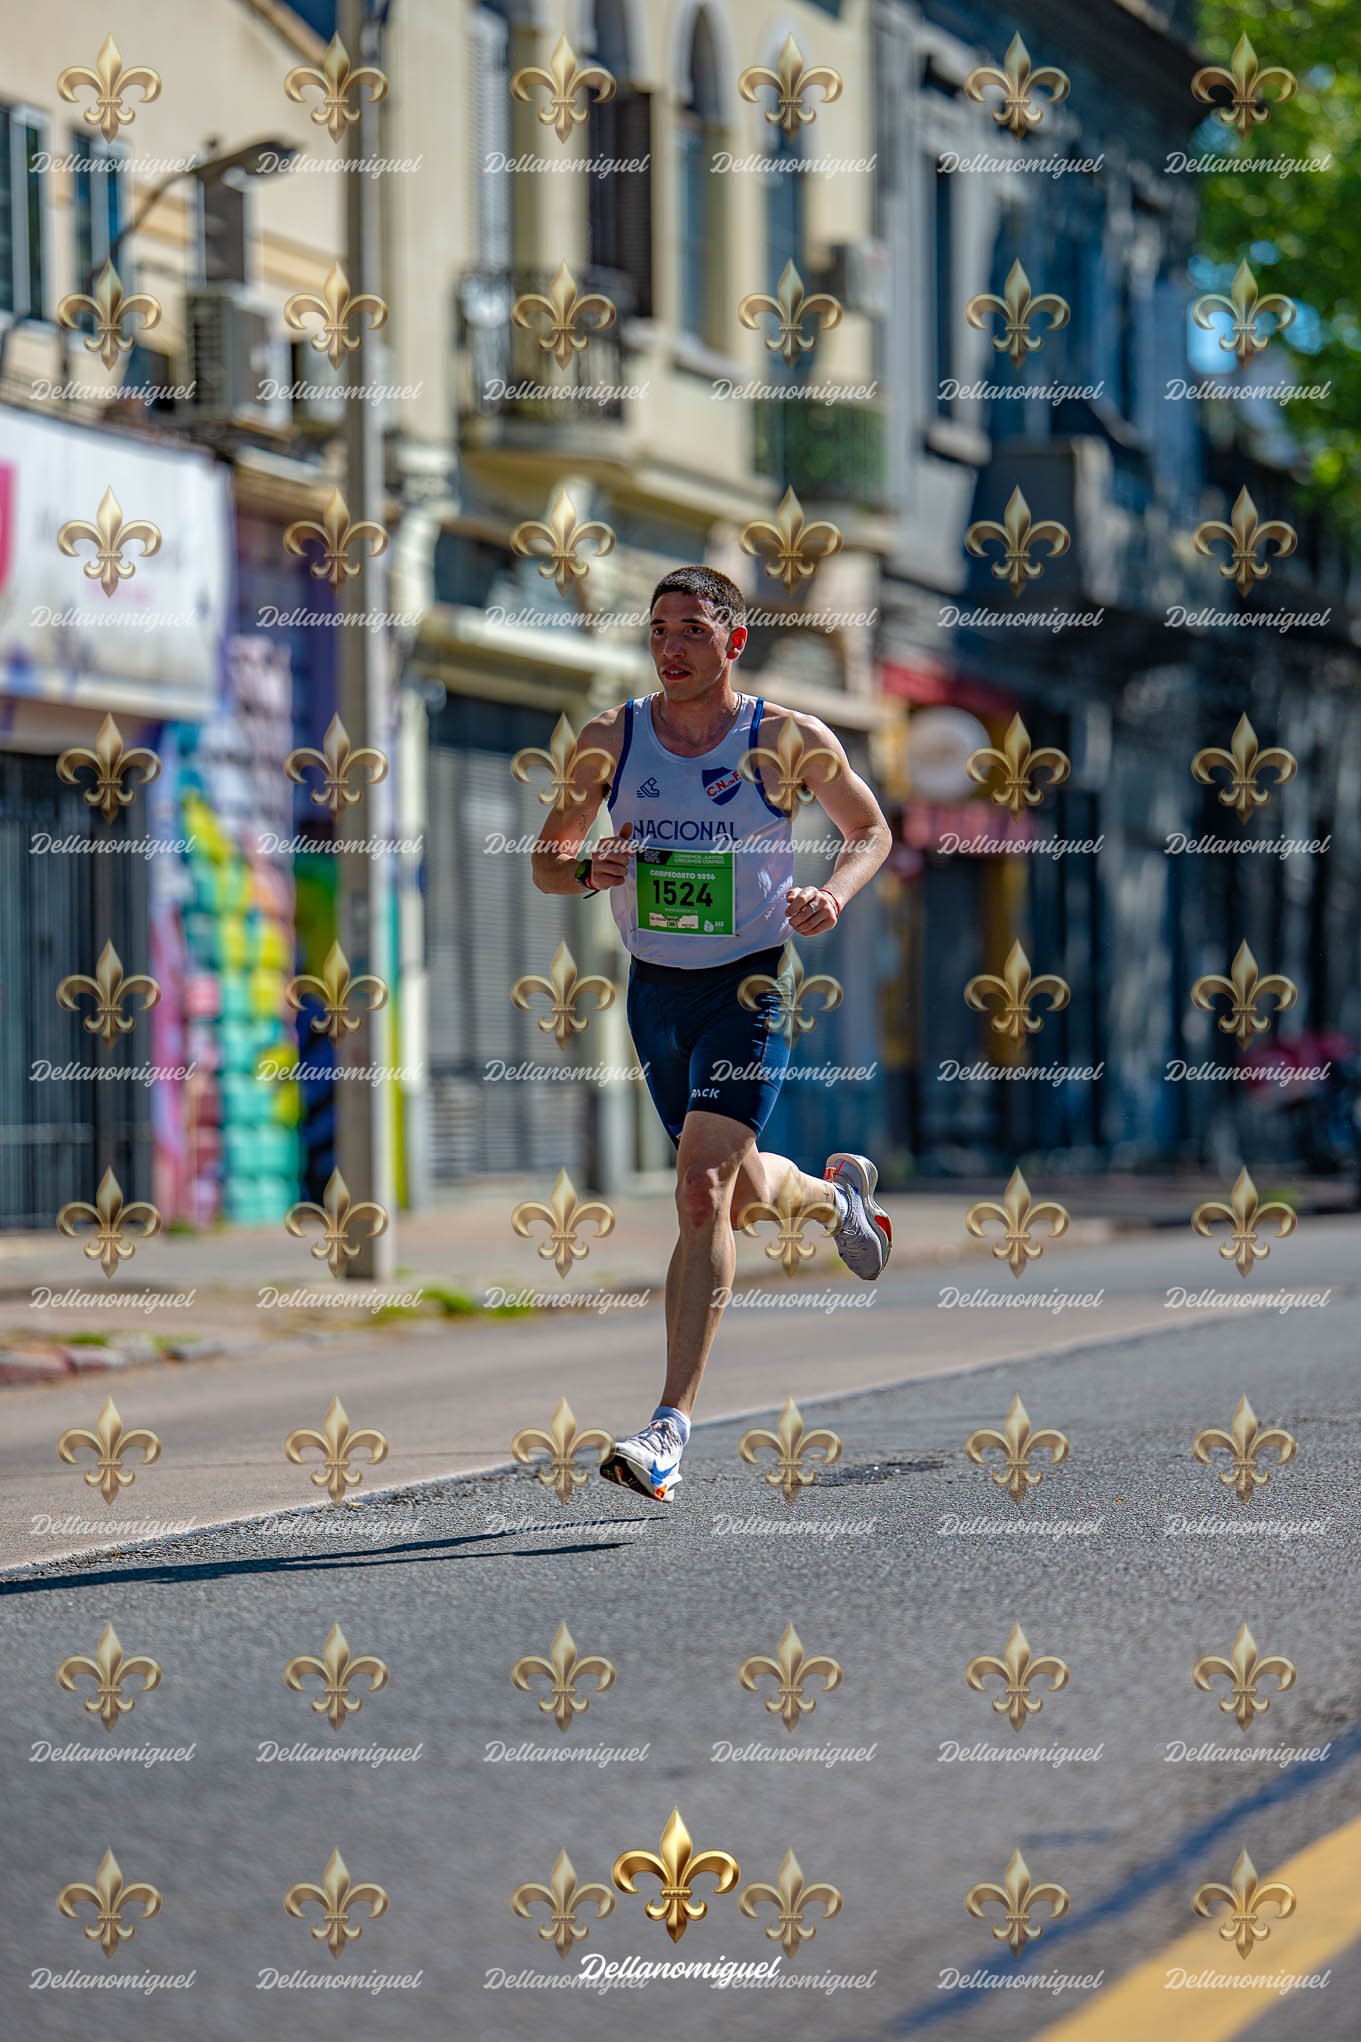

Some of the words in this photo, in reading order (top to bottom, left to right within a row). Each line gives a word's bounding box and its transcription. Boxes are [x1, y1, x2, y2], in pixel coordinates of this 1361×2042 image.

[633, 819, 738, 841] NACIONAL
[649, 869, 696, 879] CAMPEONATO
[652, 879, 713, 907] 1524
